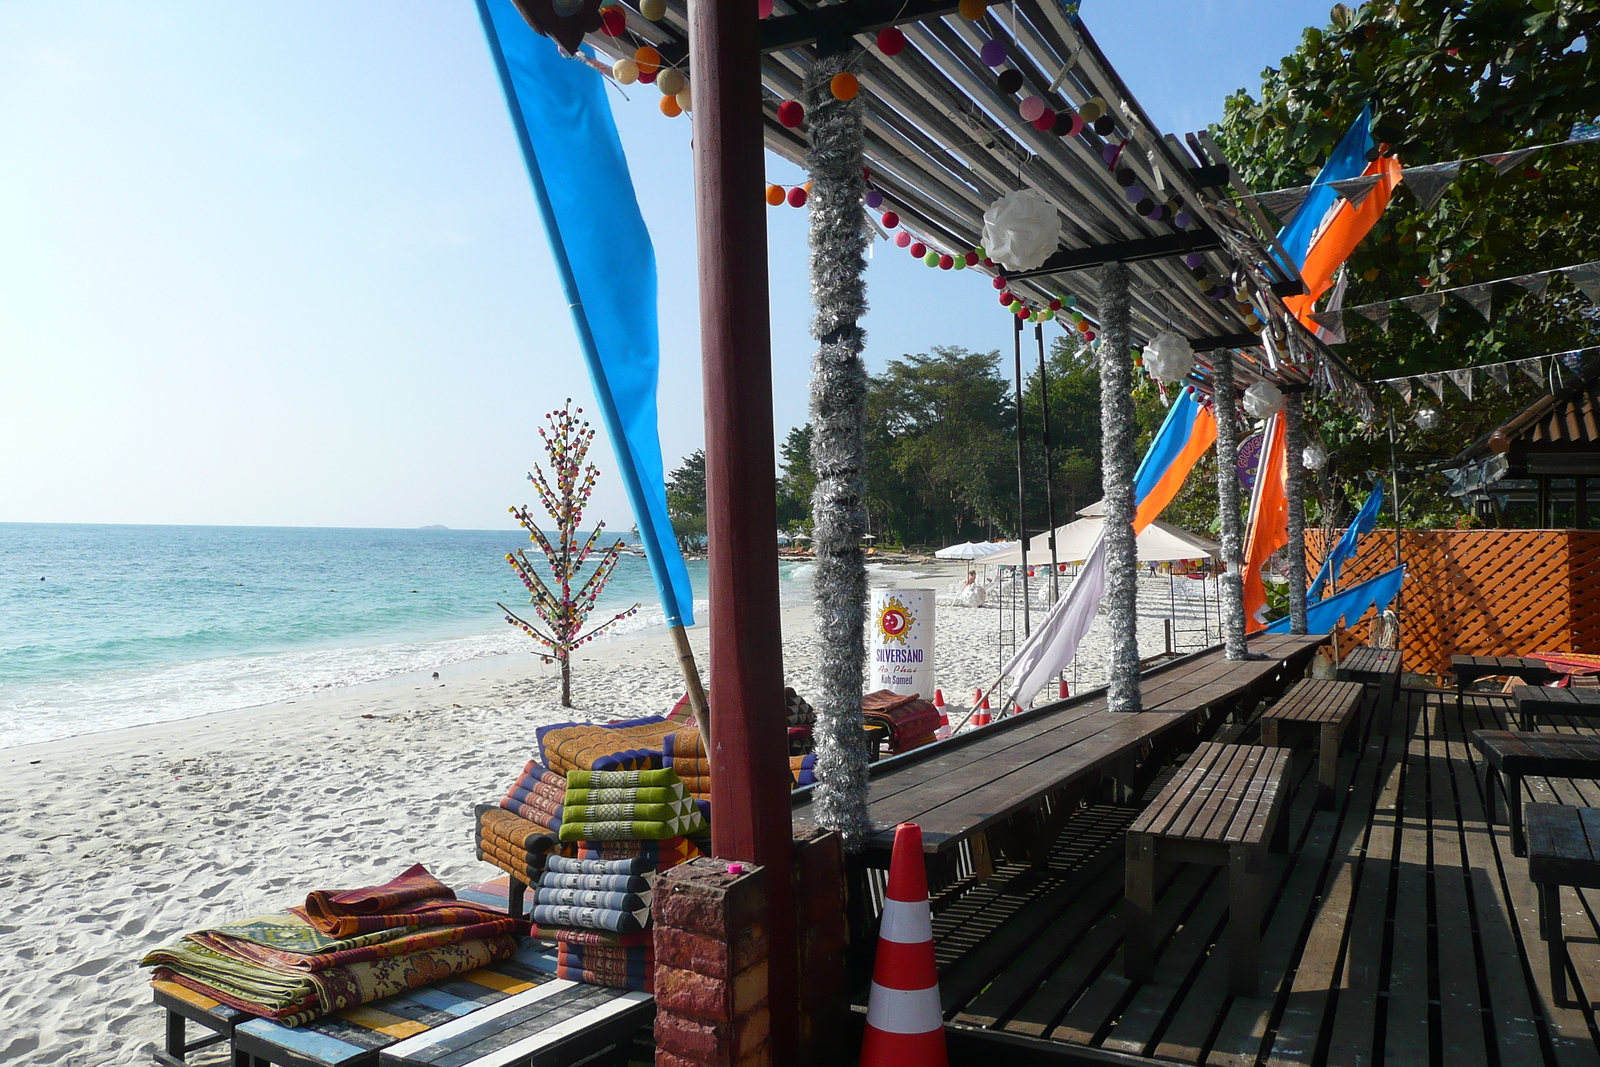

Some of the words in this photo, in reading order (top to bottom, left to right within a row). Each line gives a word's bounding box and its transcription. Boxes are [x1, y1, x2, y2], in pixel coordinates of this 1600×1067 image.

[876, 649, 923, 663] SILVERSAND
[878, 665, 889, 673] Ao
[893, 665, 917, 673] Phai
[881, 675, 891, 684] Koh
[892, 675, 913, 685] Samed
